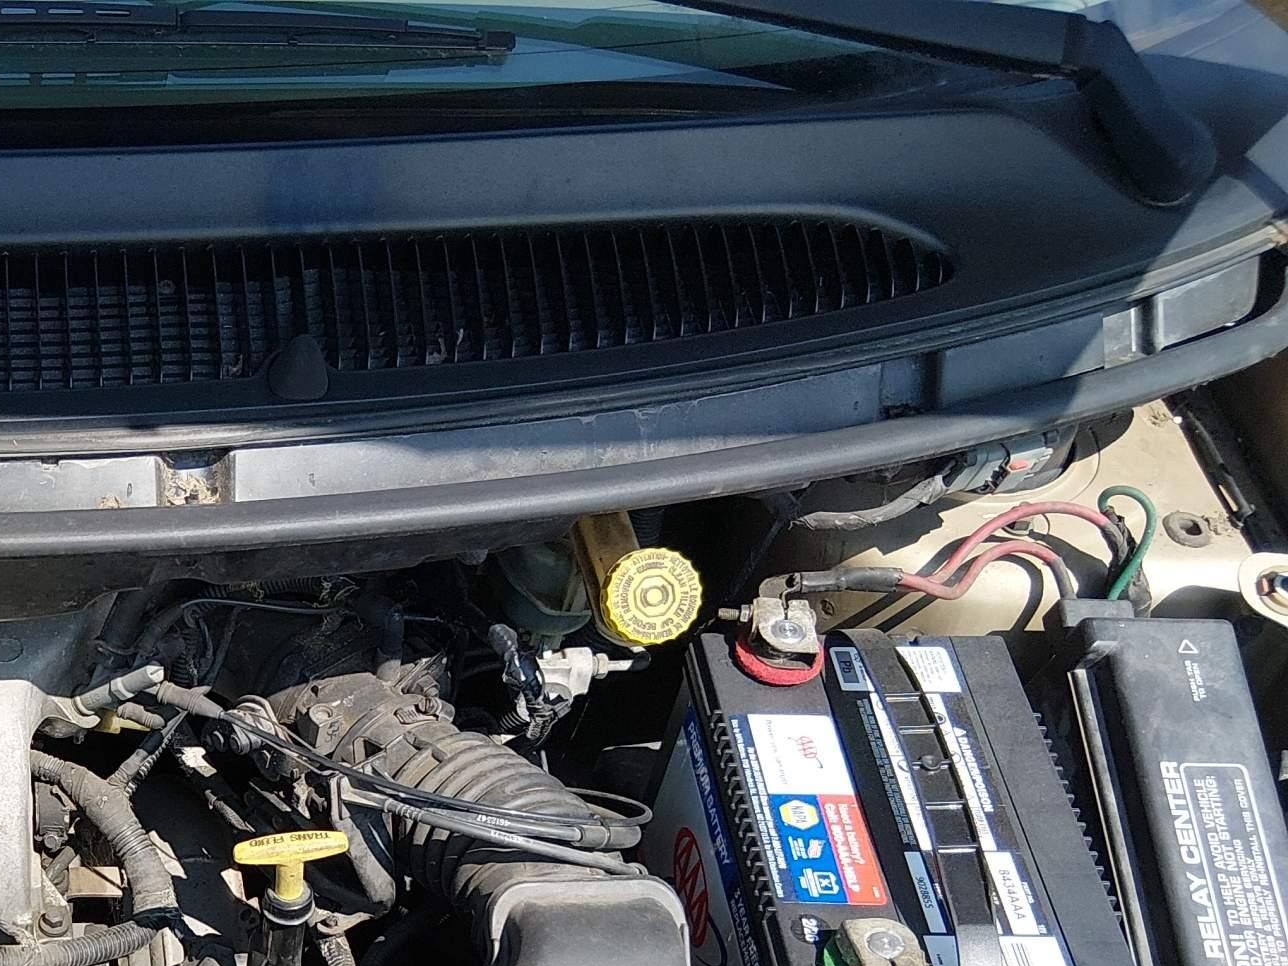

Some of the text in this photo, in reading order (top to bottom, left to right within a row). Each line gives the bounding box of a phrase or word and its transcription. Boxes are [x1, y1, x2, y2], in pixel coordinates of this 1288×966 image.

[838, 659, 854, 674] Pb
[687, 721, 730, 865] PREMIUM BATTERY
[1192, 778, 1216, 828] VEHICLE
[789, 805, 809, 824] NAPA
[1158, 760, 1202, 864] CENTER
[249, 832, 332, 848] TRANS FLUID
[1205, 832, 1226, 868] AVOID
[1221, 844, 1239, 871] NOT
[1245, 857, 1259, 881] ONLY
[674, 827, 708, 947] AAA
[1215, 872, 1235, 905] HELP
[1229, 875, 1253, 925] ENGINE
[1185, 871, 1225, 959] RELAY
[1225, 909, 1241, 926] TO
[1274, 939, 1286, 951] TO
